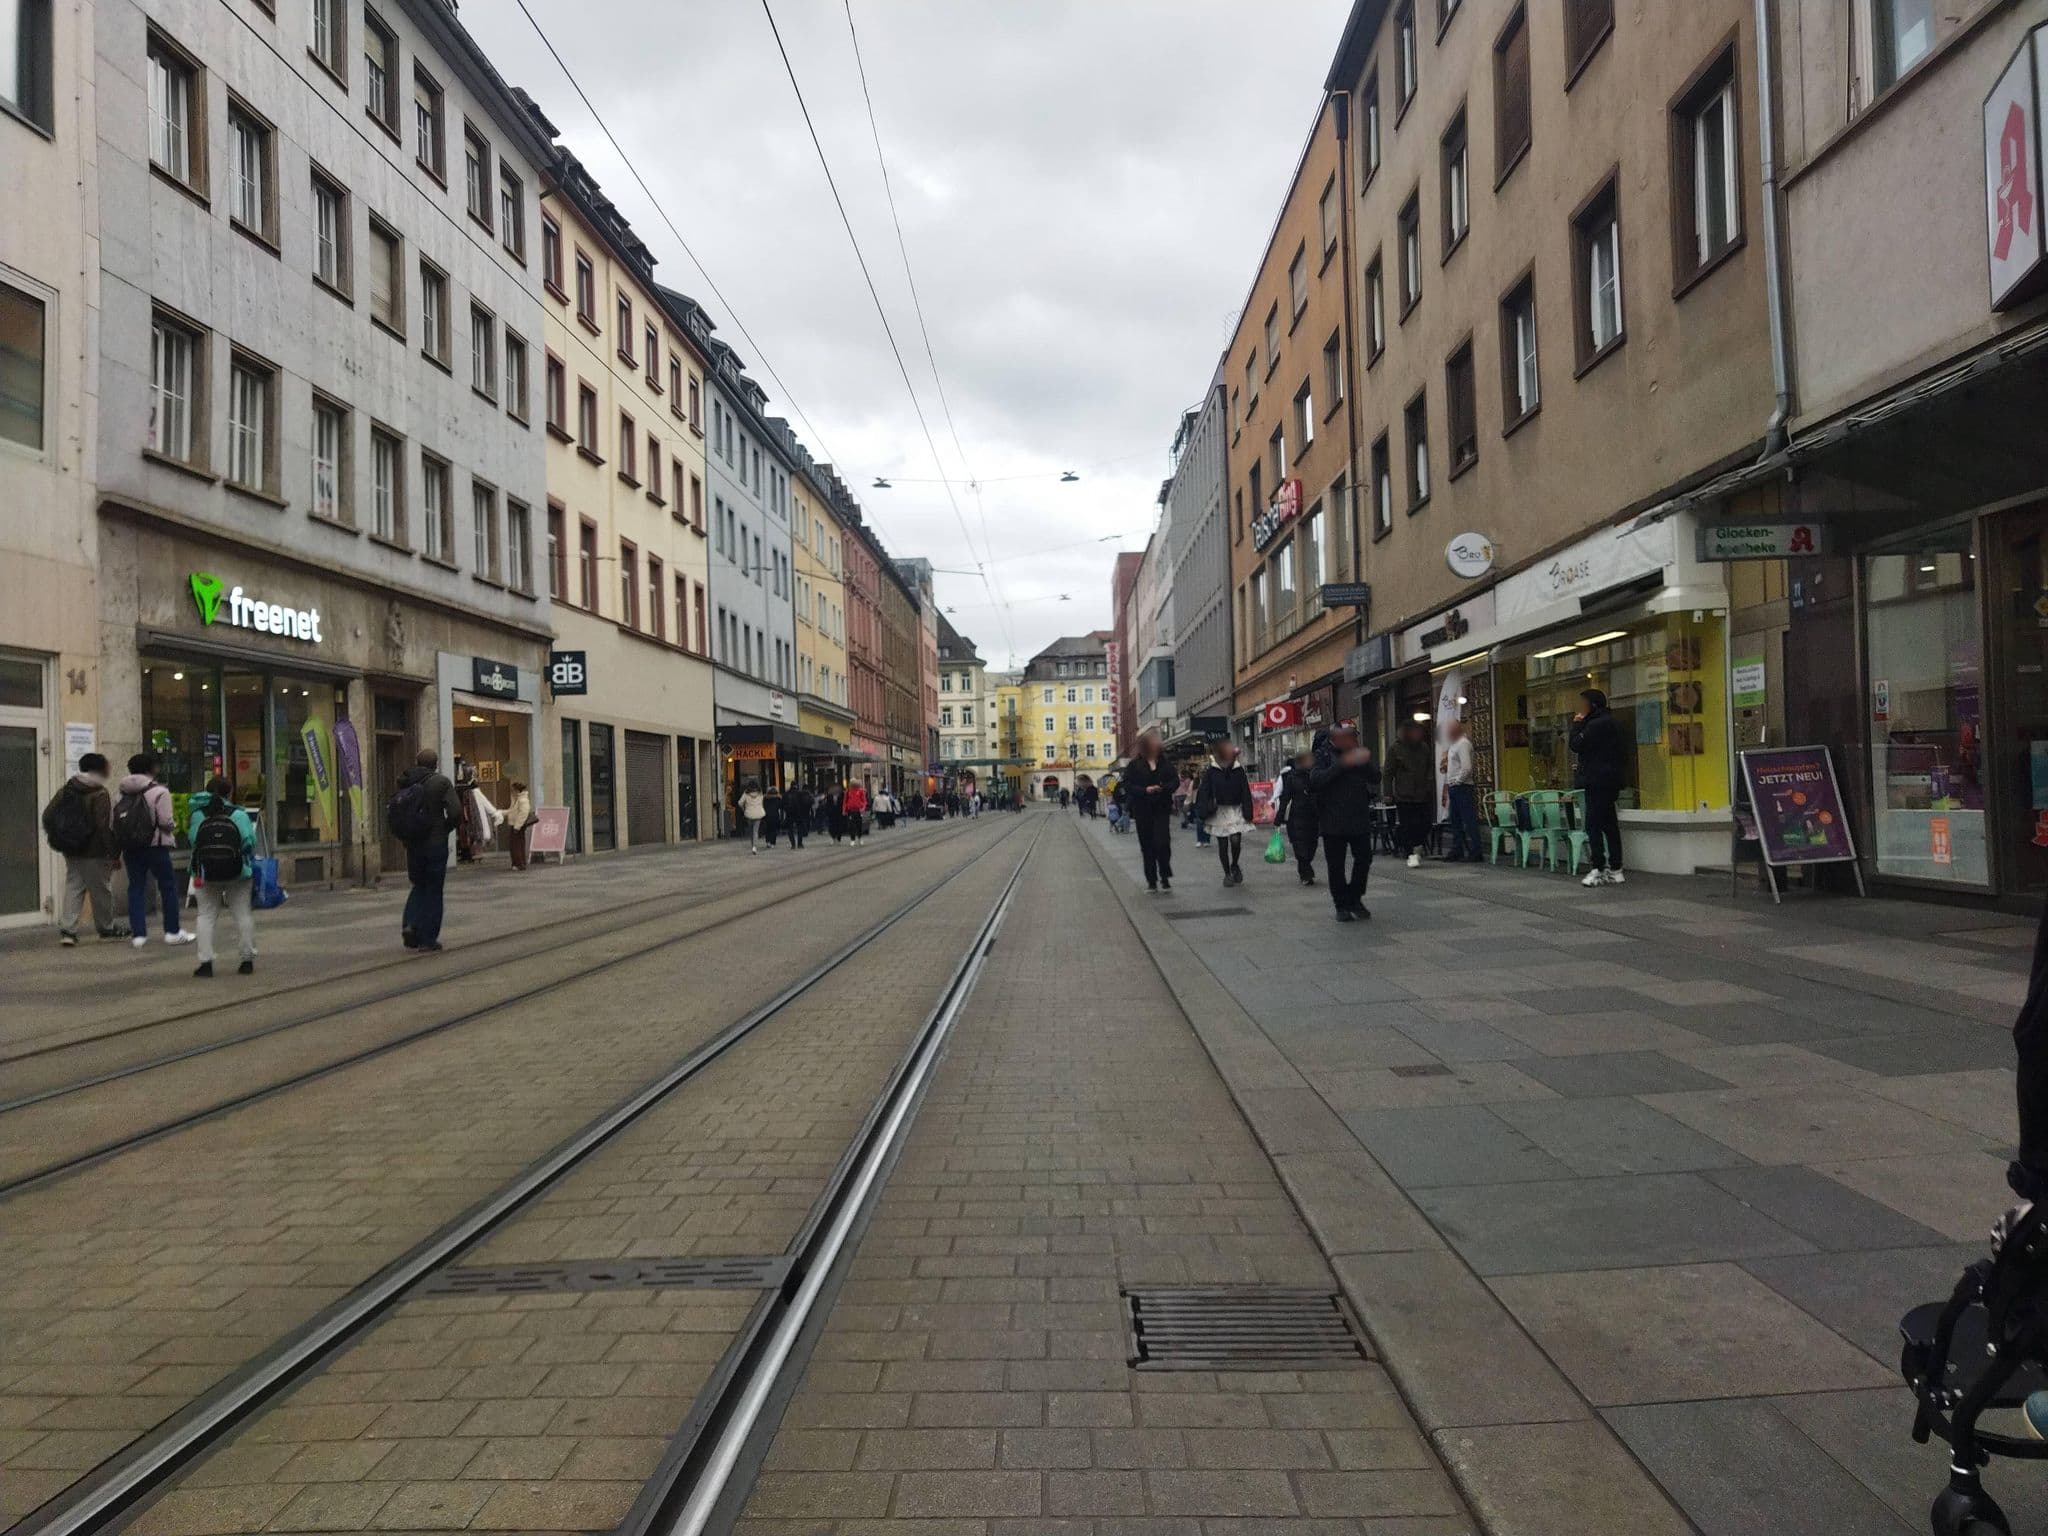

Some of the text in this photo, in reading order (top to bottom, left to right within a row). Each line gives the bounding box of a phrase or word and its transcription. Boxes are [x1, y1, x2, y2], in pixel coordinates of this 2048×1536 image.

[1279, 480, 1297, 522] Ring
[1716, 527, 1774, 539] Glocken-
[230, 586, 323, 643] freenet
[67, 668, 87, 696] 14
[1758, 773, 1793, 785] JETZT
